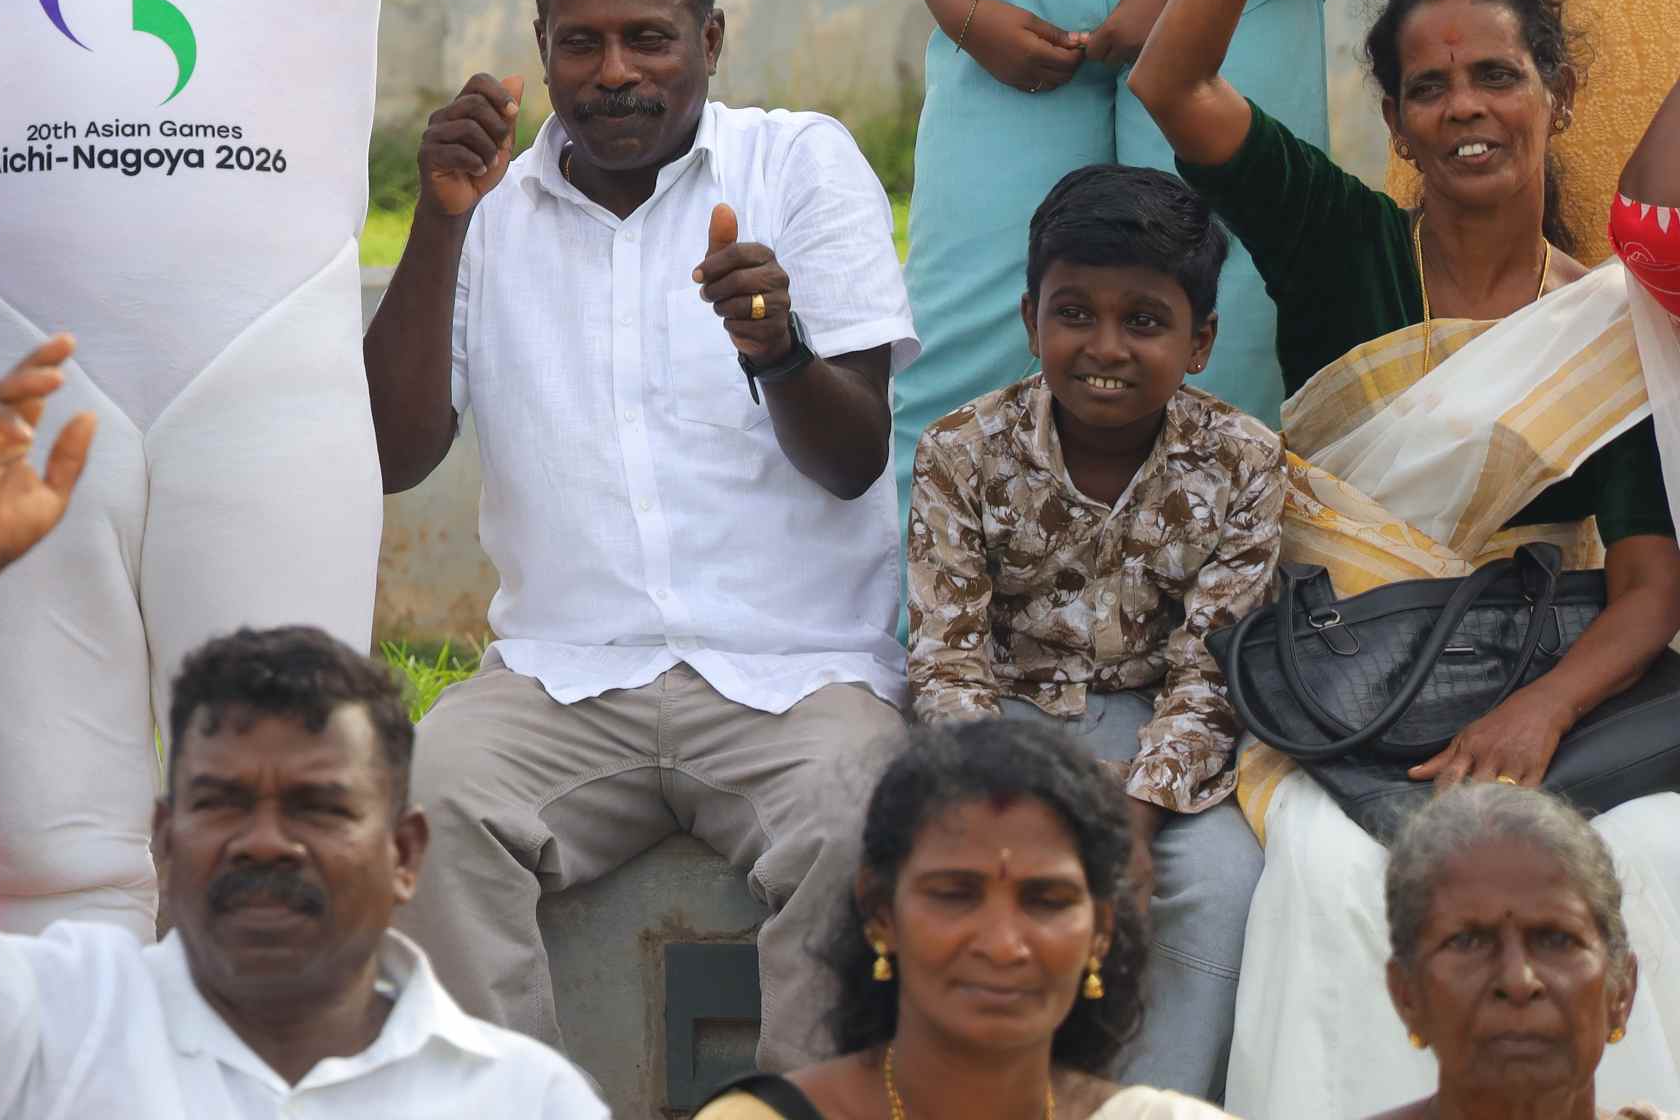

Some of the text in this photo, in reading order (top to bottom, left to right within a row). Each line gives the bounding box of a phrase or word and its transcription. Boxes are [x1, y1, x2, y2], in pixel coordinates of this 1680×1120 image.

[26, 118, 243, 141] 20th Asian Games
[215, 144, 287, 174] 2026
